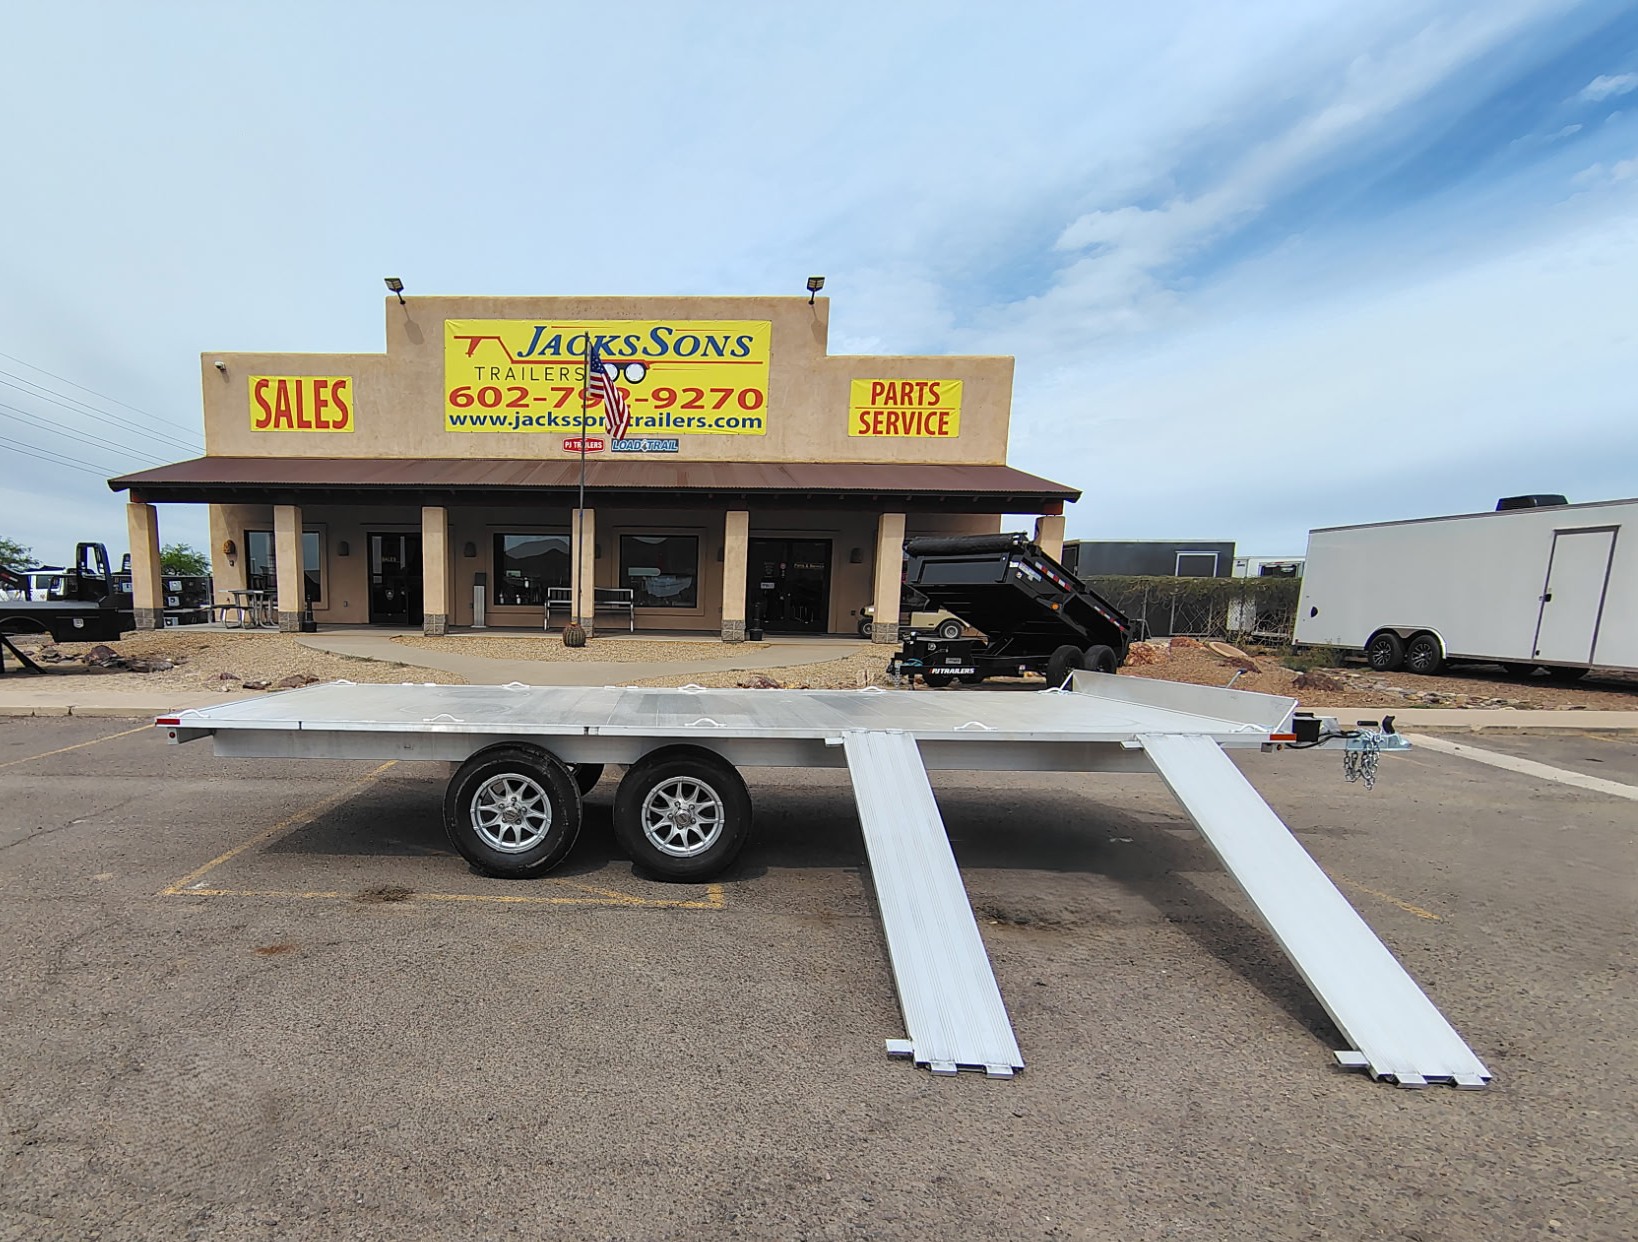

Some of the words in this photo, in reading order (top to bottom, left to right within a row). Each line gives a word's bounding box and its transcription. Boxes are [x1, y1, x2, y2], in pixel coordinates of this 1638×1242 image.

[474, 367, 585, 381] TRAILERS
[255, 379, 349, 429] SALES
[871, 382, 940, 406] PARTS
[449, 411, 762, 430] www.jackssorailers.com
[858, 411, 950, 435] SERVICE
[613, 440, 640, 450] LOAD
[648, 440, 678, 450] TRAIL
